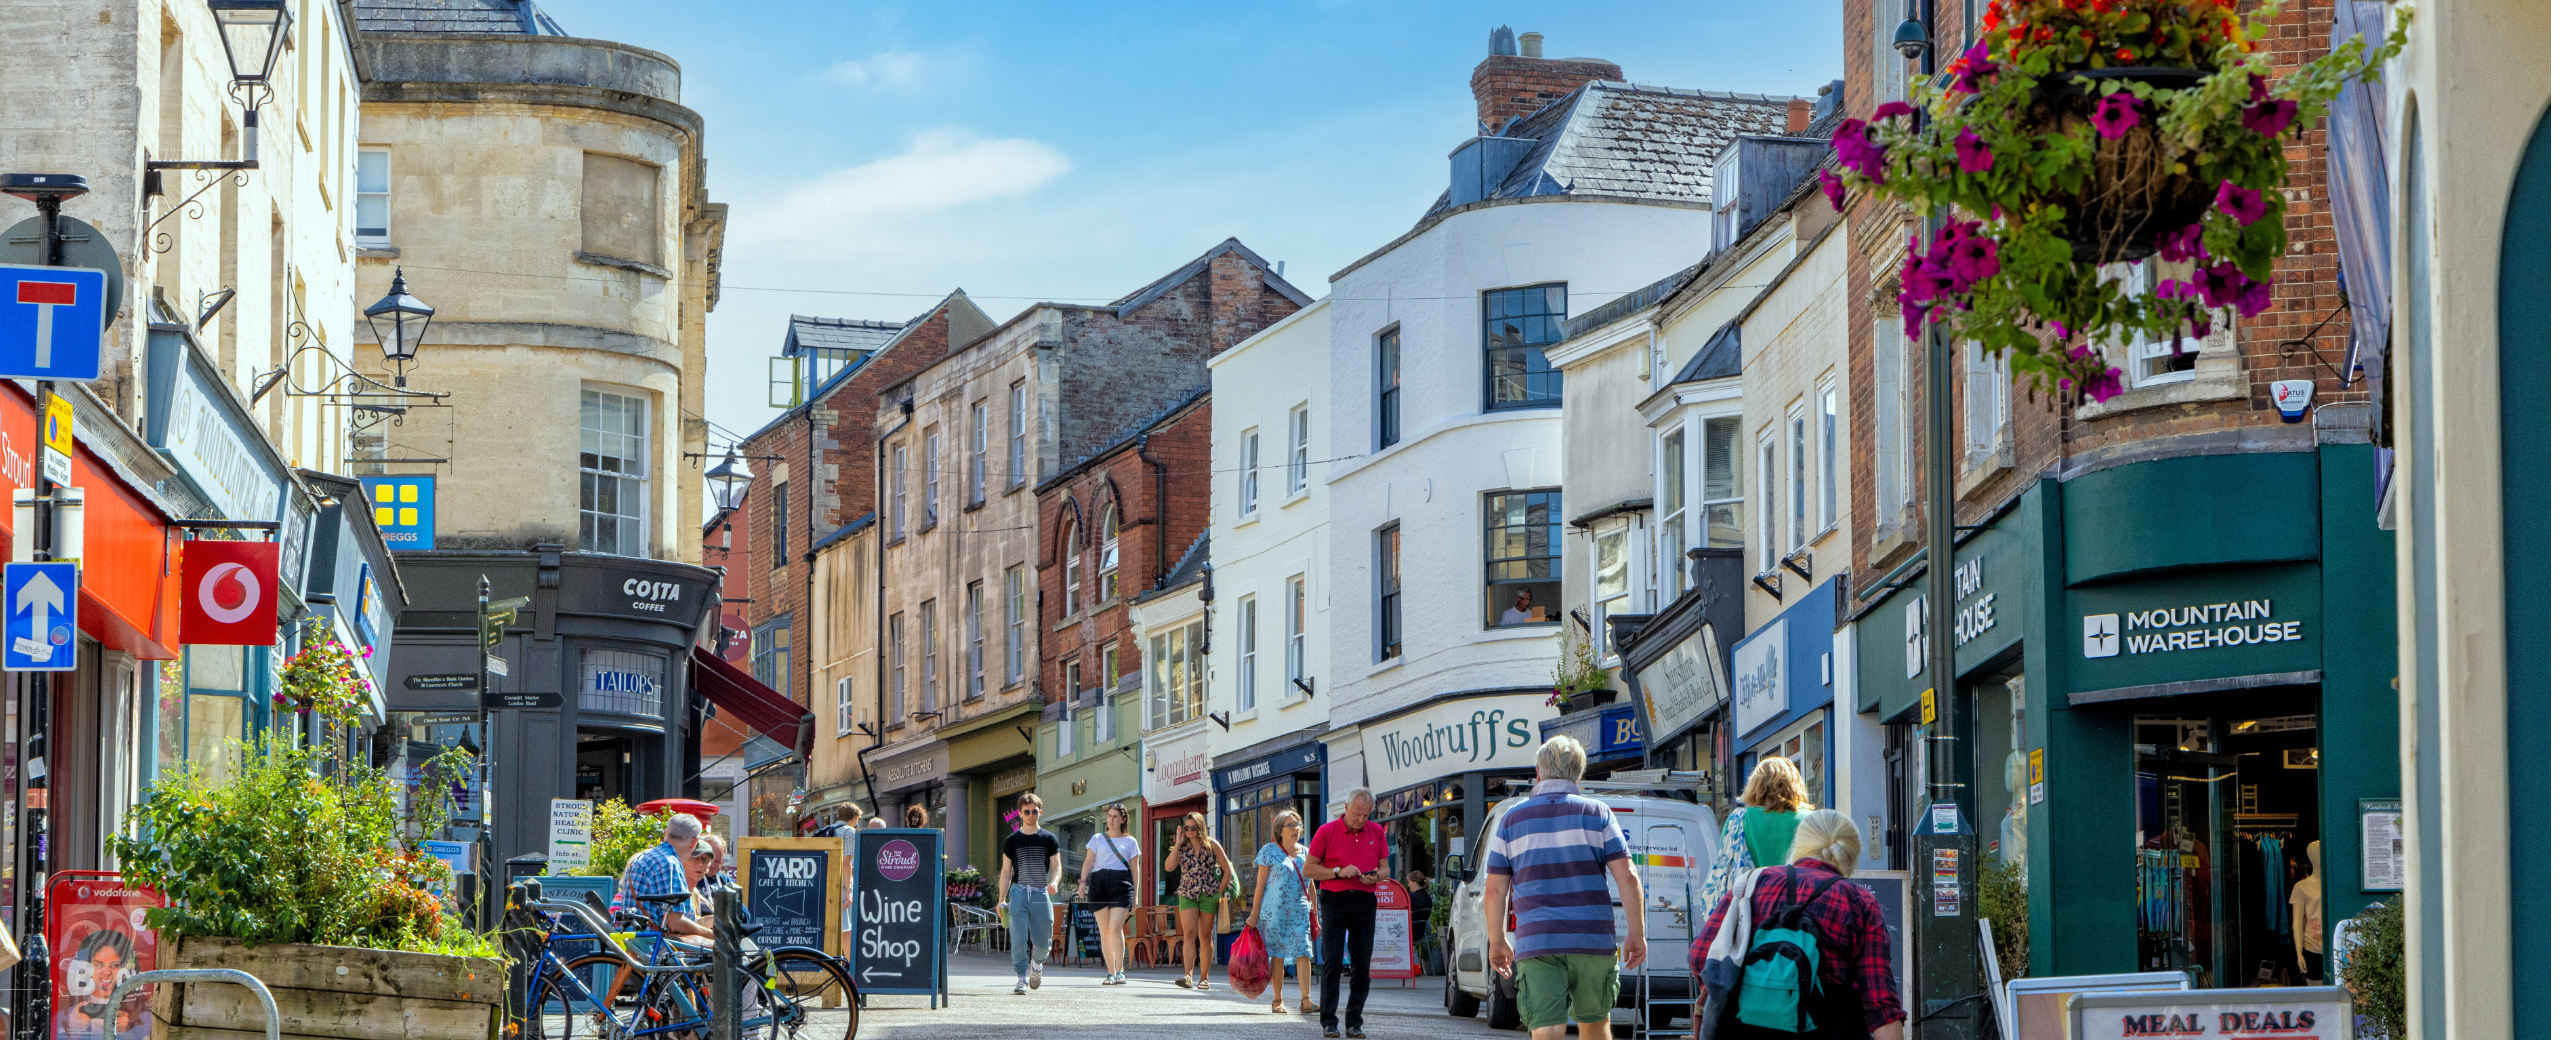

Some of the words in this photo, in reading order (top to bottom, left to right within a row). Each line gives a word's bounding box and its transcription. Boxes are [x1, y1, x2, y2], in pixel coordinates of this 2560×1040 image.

[2, 431, 30, 489] Stroud
[383, 532, 418, 542] REGGS
[623, 578, 680, 601] COSTA
[633, 601, 665, 612] COFFEE
[2128, 599, 2270, 631] MOUNTAIN
[2127, 621, 2302, 655] WAREHOUSE
[598, 671, 654, 695] TAILORS
[1662, 652, 1695, 693] Sunshine
[1922, 691, 1933, 721] H
[1381, 709, 1531, 772] Woodruffs
[888, 764, 910, 782] ABSOLUTE
[910, 757, 932, 777] KITCHENS
[1157, 750, 1208, 788] Loganberry
[1231, 766, 1252, 784] BRILLIANT
[1251, 761, 1271, 778] DISGUISE
[557, 828, 584, 836] CLINIC
[432, 846, 461, 854] GREGGS
[879, 850, 917, 866] Stroud
[764, 857, 817, 879] YARD
[93, 887, 141, 898] vodafone
[542, 888, 587, 900] ONFLOW
[758, 879, 775, 887] CAFE
[785, 879, 814, 887] KITCHEN
[859, 889, 922, 924] Wine
[790, 917, 811, 926] BRUNCH
[757, 935, 782, 945] OUTSIDE
[786, 936, 814, 945] SEATING
[862, 925, 920, 968] Shop
[2122, 1012, 2206, 1037] MEAL
[2218, 1010, 2315, 1035] DEALS
